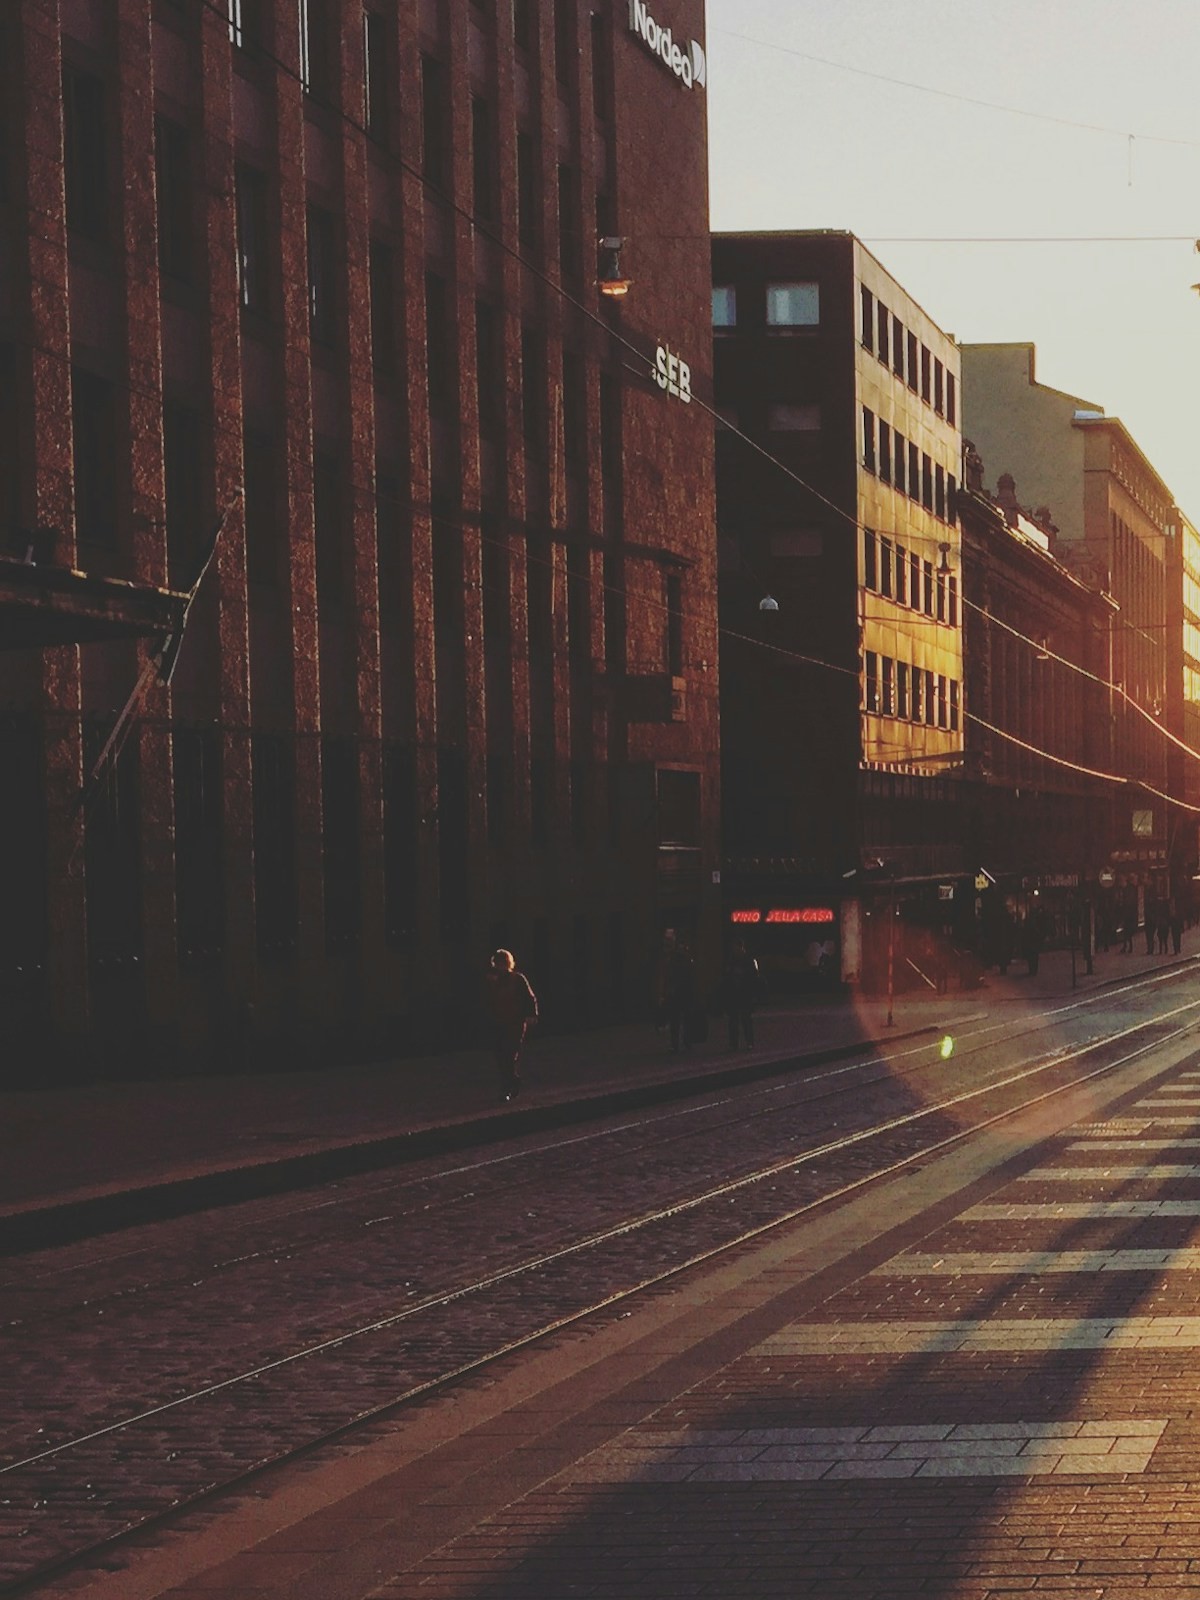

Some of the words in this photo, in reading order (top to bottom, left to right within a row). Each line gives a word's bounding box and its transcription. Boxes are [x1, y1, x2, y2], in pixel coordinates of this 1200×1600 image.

[632, 0, 692, 89] Nordea
[653, 345, 691, 404] SEB
[732, 911, 760, 922] VINO
[801, 908, 833, 922] CASA
